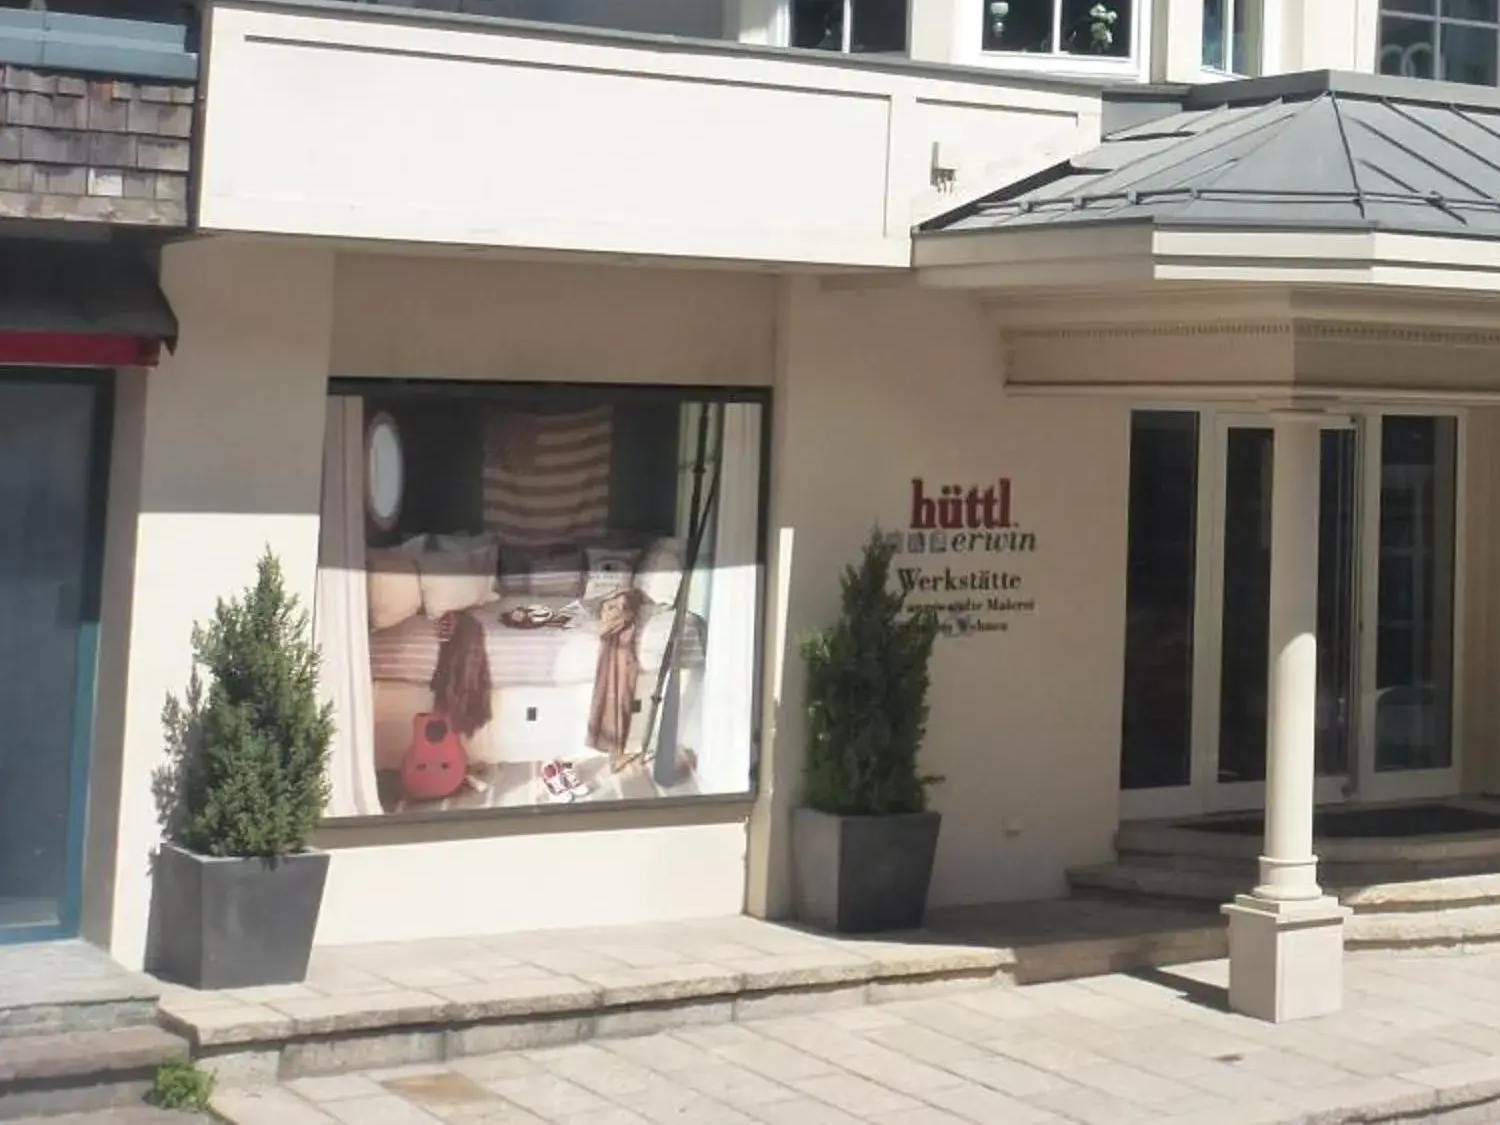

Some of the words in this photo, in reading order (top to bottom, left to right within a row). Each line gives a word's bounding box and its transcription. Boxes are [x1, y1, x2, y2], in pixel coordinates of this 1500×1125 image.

[910, 477, 1011, 529] hüttl
[952, 523, 1036, 553] erwin
[897, 567, 1022, 592] Werkstätte
